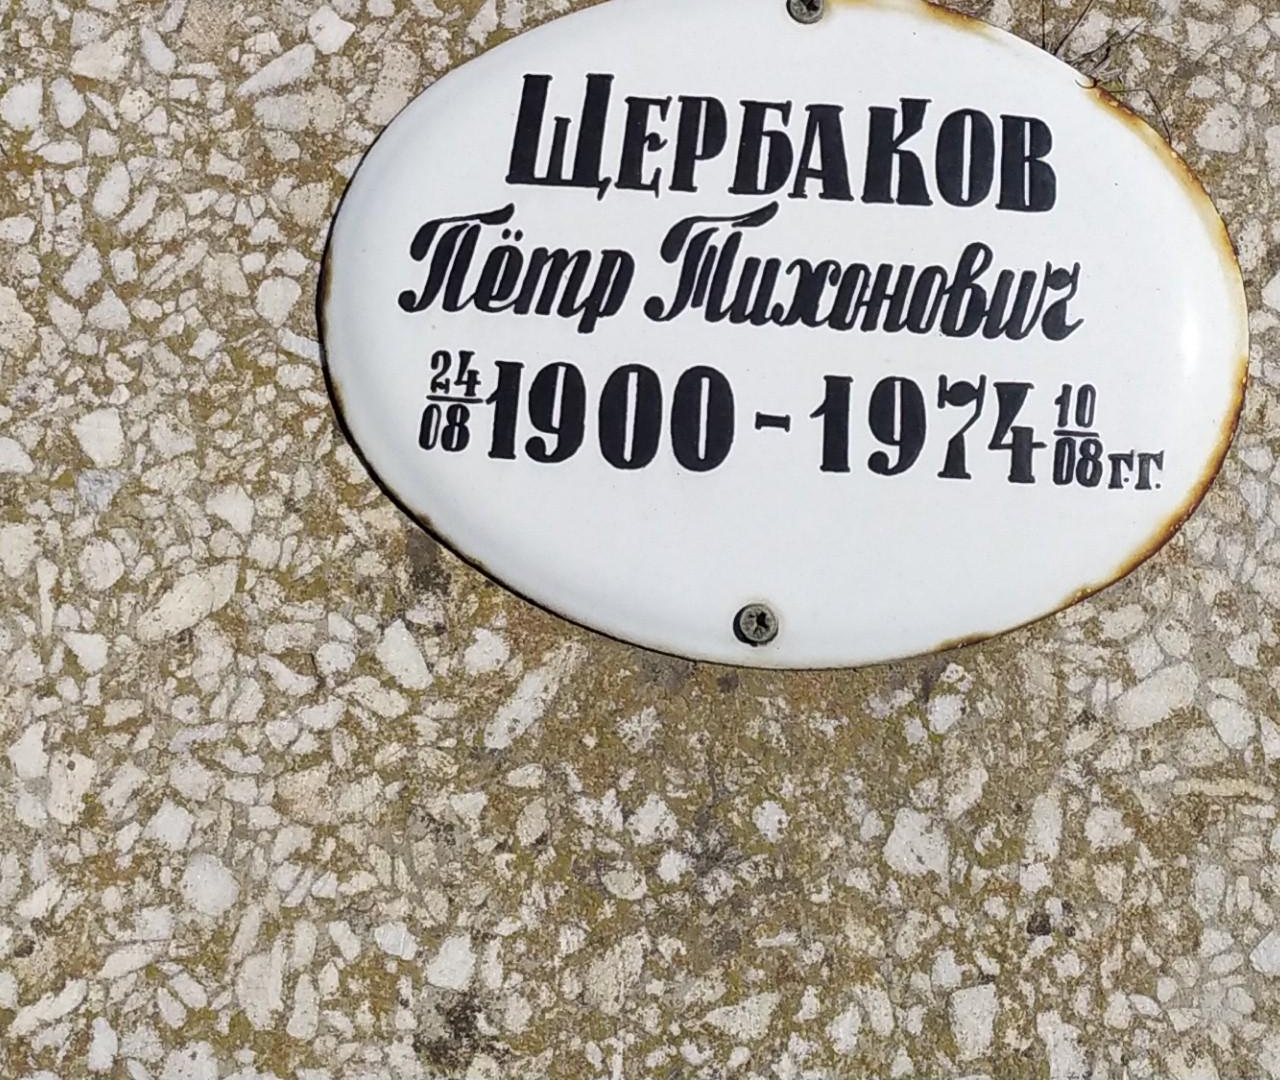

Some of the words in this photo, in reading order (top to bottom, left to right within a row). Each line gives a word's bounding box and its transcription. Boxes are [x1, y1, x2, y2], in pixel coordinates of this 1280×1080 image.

[505, 73, 1057, 213] ЩЕРБАКОВ
[397, 203, 636, 334] Пётр
[643, 201, 1085, 342] Тихонович
[485, 360, 736, 474] 1900
[808, 374, 1047, 485] 1974
